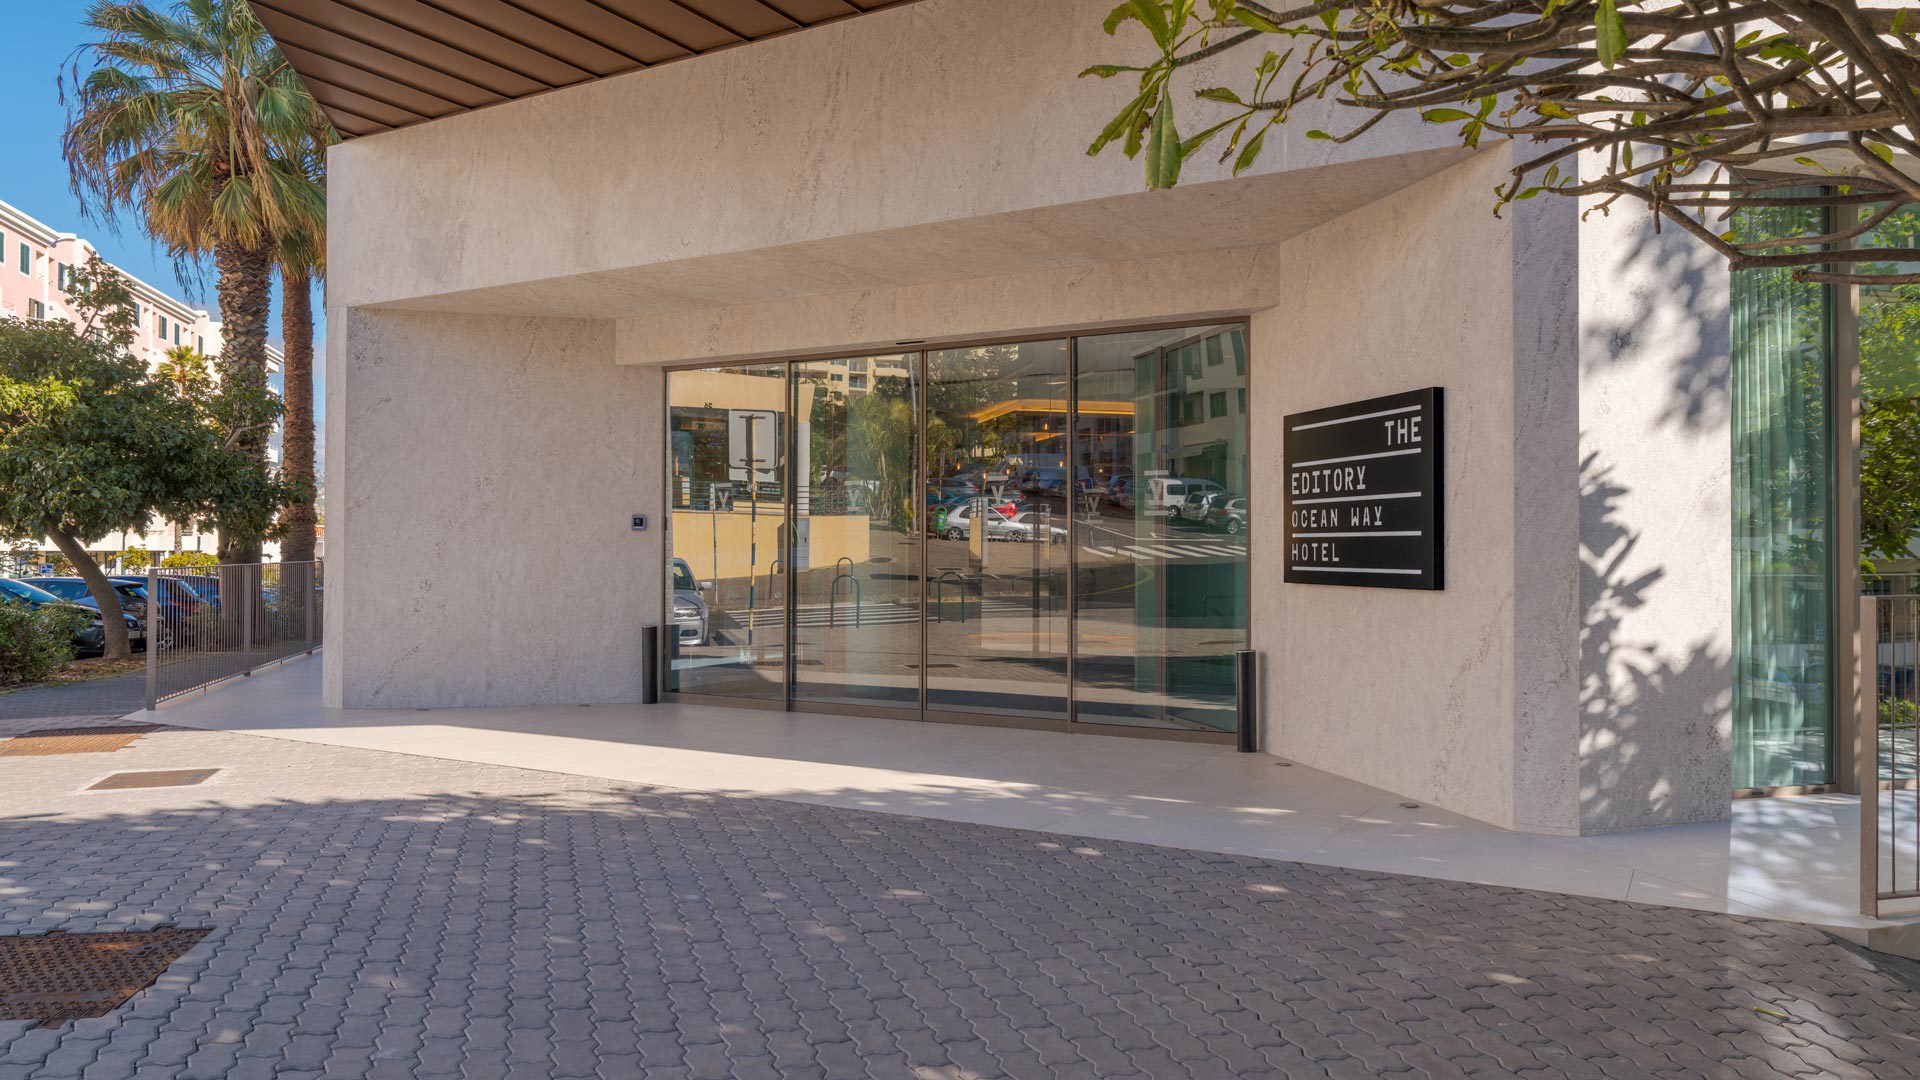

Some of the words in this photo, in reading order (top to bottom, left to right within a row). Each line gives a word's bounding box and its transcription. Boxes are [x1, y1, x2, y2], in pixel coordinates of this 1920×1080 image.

[1385, 416, 1422, 446] THE
[1291, 465, 1367, 495] EDITORY
[1291, 508, 1338, 528] OCEAN
[1351, 506, 1383, 527] WAY
[1291, 543, 1340, 562] HOTEL
